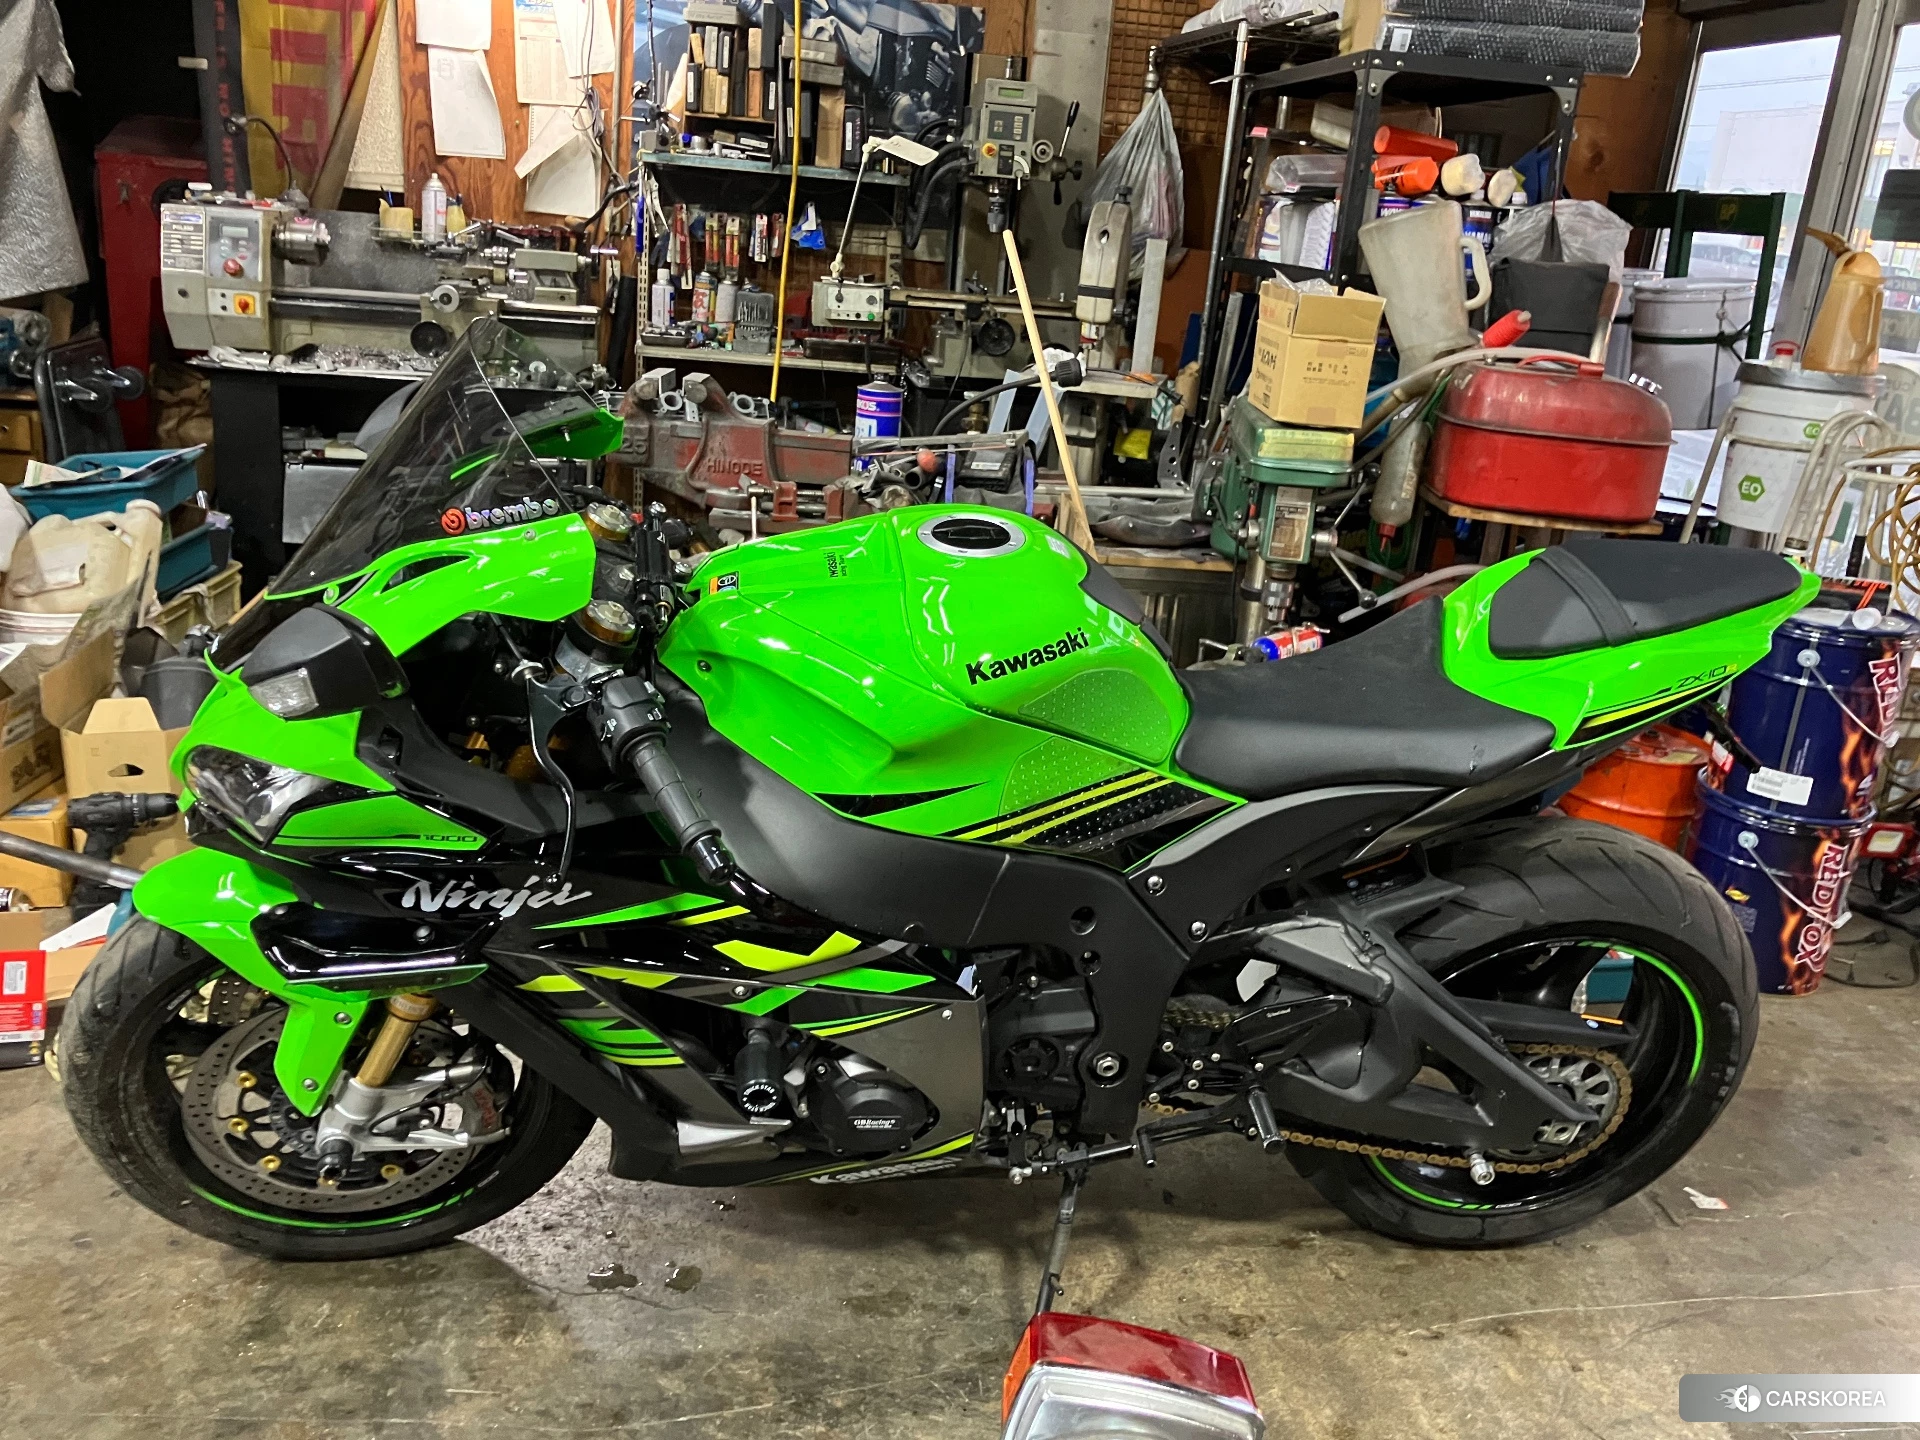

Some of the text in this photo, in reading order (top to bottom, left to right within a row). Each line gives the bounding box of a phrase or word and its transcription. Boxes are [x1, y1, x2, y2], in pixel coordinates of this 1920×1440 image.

[706, 457, 763, 477] HINODE
[464, 496, 560, 530] brembo
[965, 627, 1090, 686] Kawasaki
[1675, 663, 1738, 690] ZX-10R
[423, 834, 477, 843] 1000
[401, 875, 593, 918] Ninja
